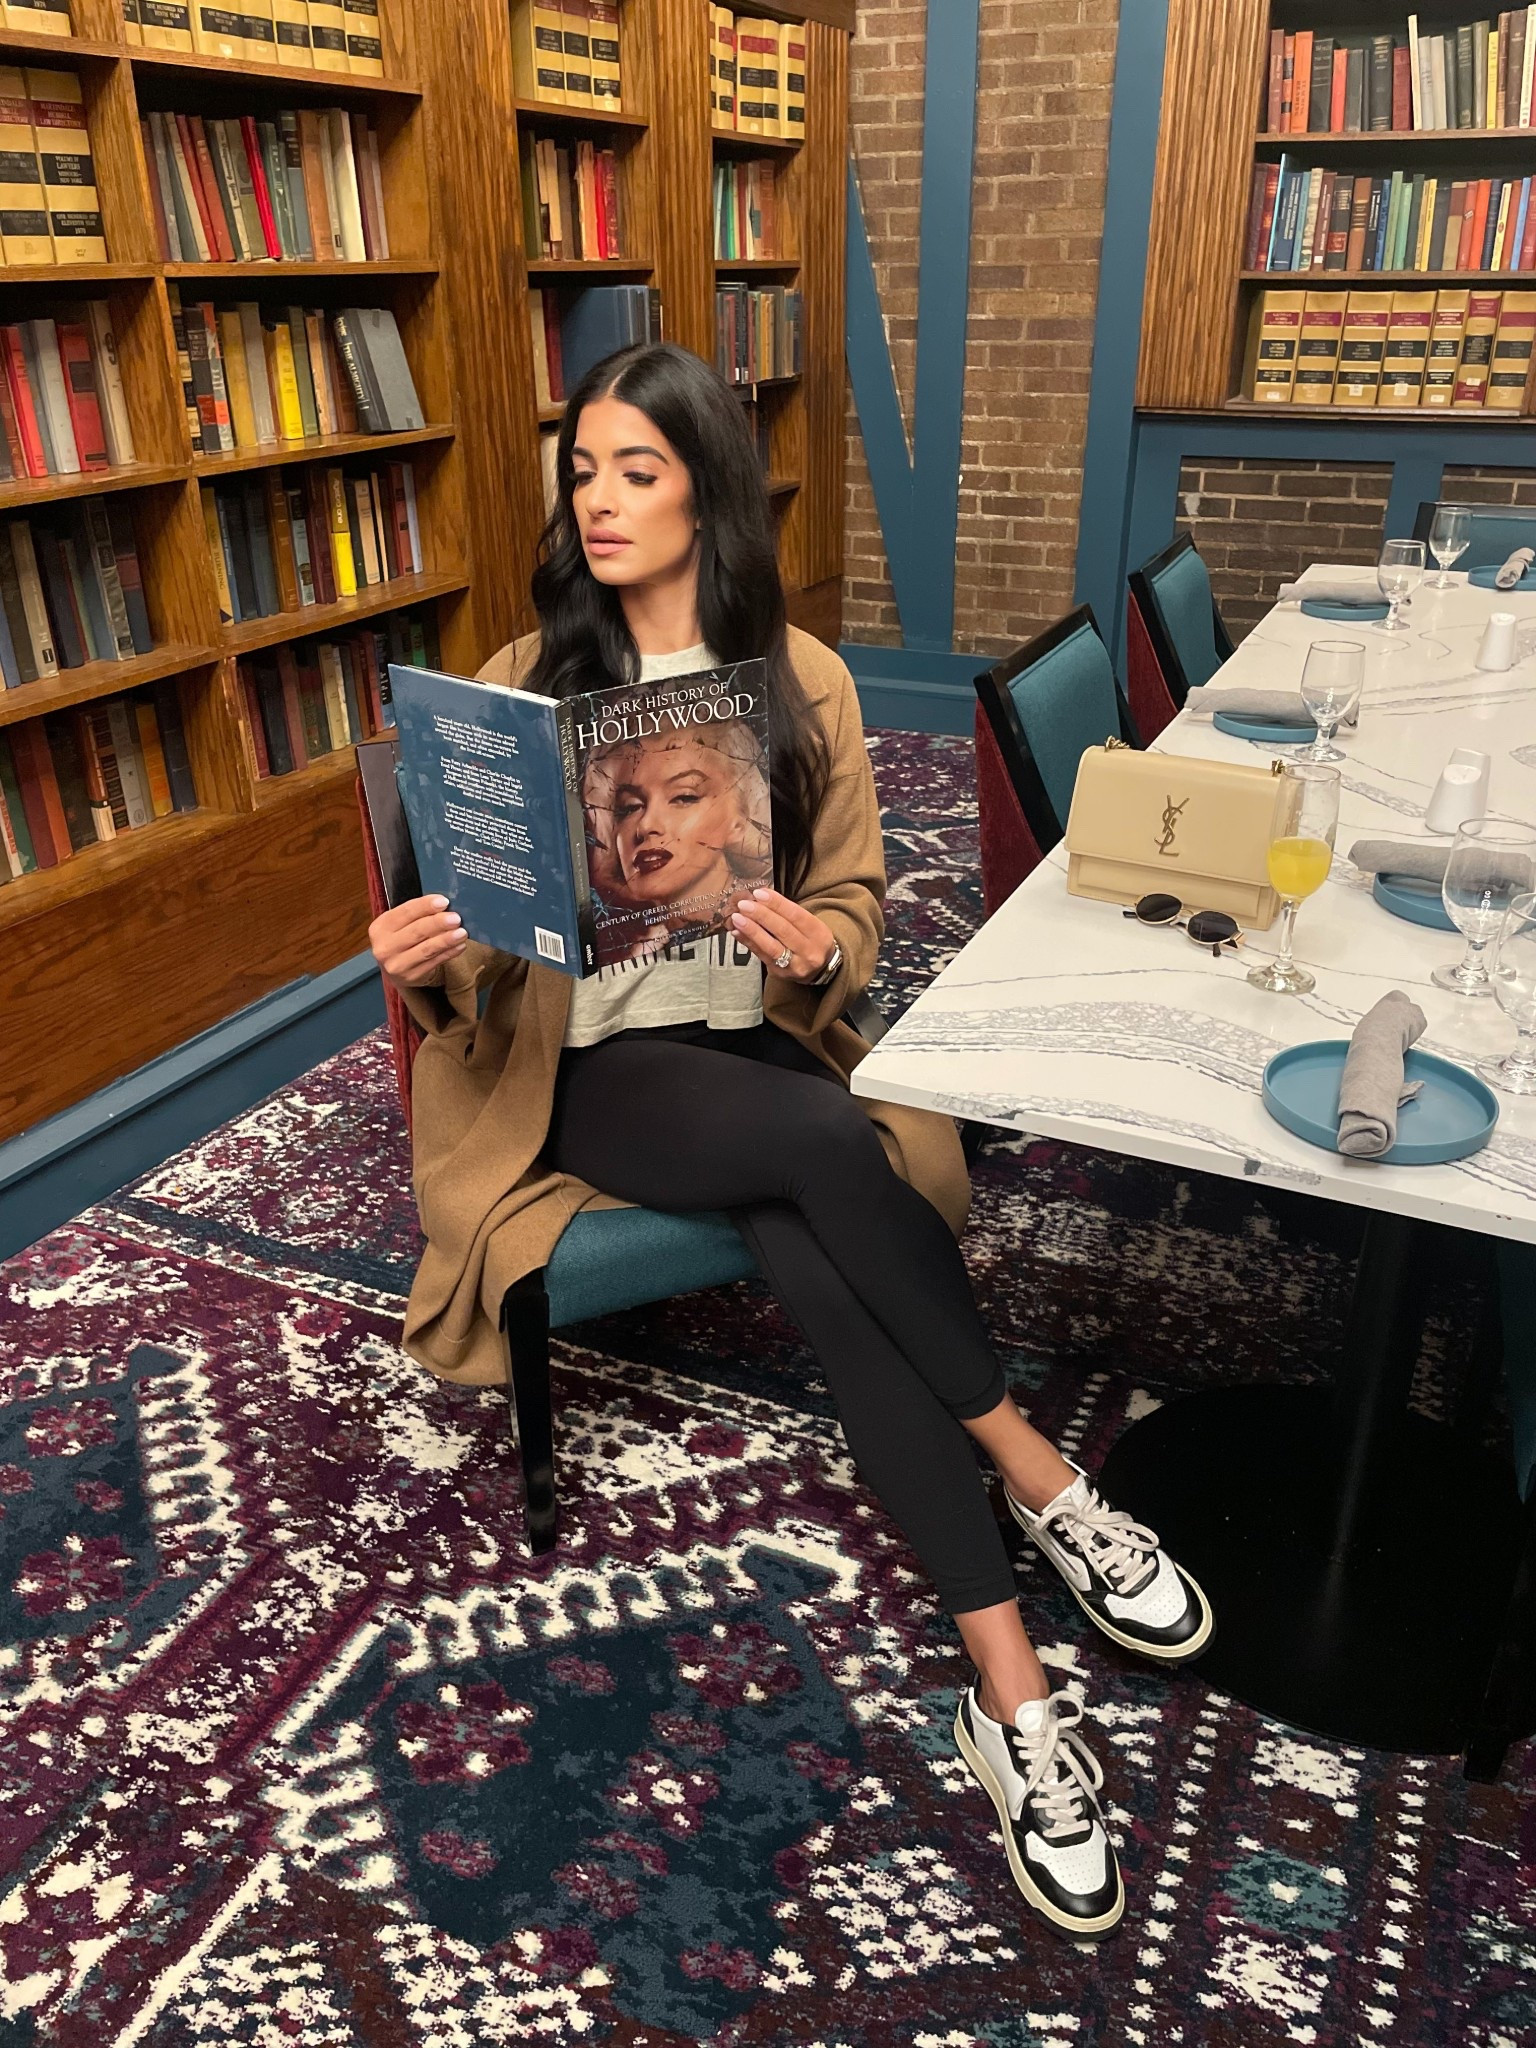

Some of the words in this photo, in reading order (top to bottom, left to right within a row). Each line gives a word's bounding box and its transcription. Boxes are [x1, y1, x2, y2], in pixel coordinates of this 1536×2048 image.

[601, 699, 641, 719] DARK
[646, 685, 705, 709] HISTORY
[709, 681, 728, 695] OF
[575, 693, 754, 751] HOLLYWOOD
[595, 914, 631, 931] CENTURY
[630, 911, 642, 921] OF
[718, 887, 734, 897] AND
[645, 912, 673, 926] BEHIND
[673, 908, 688, 919] THE
[688, 902, 716, 915] MOVIES
